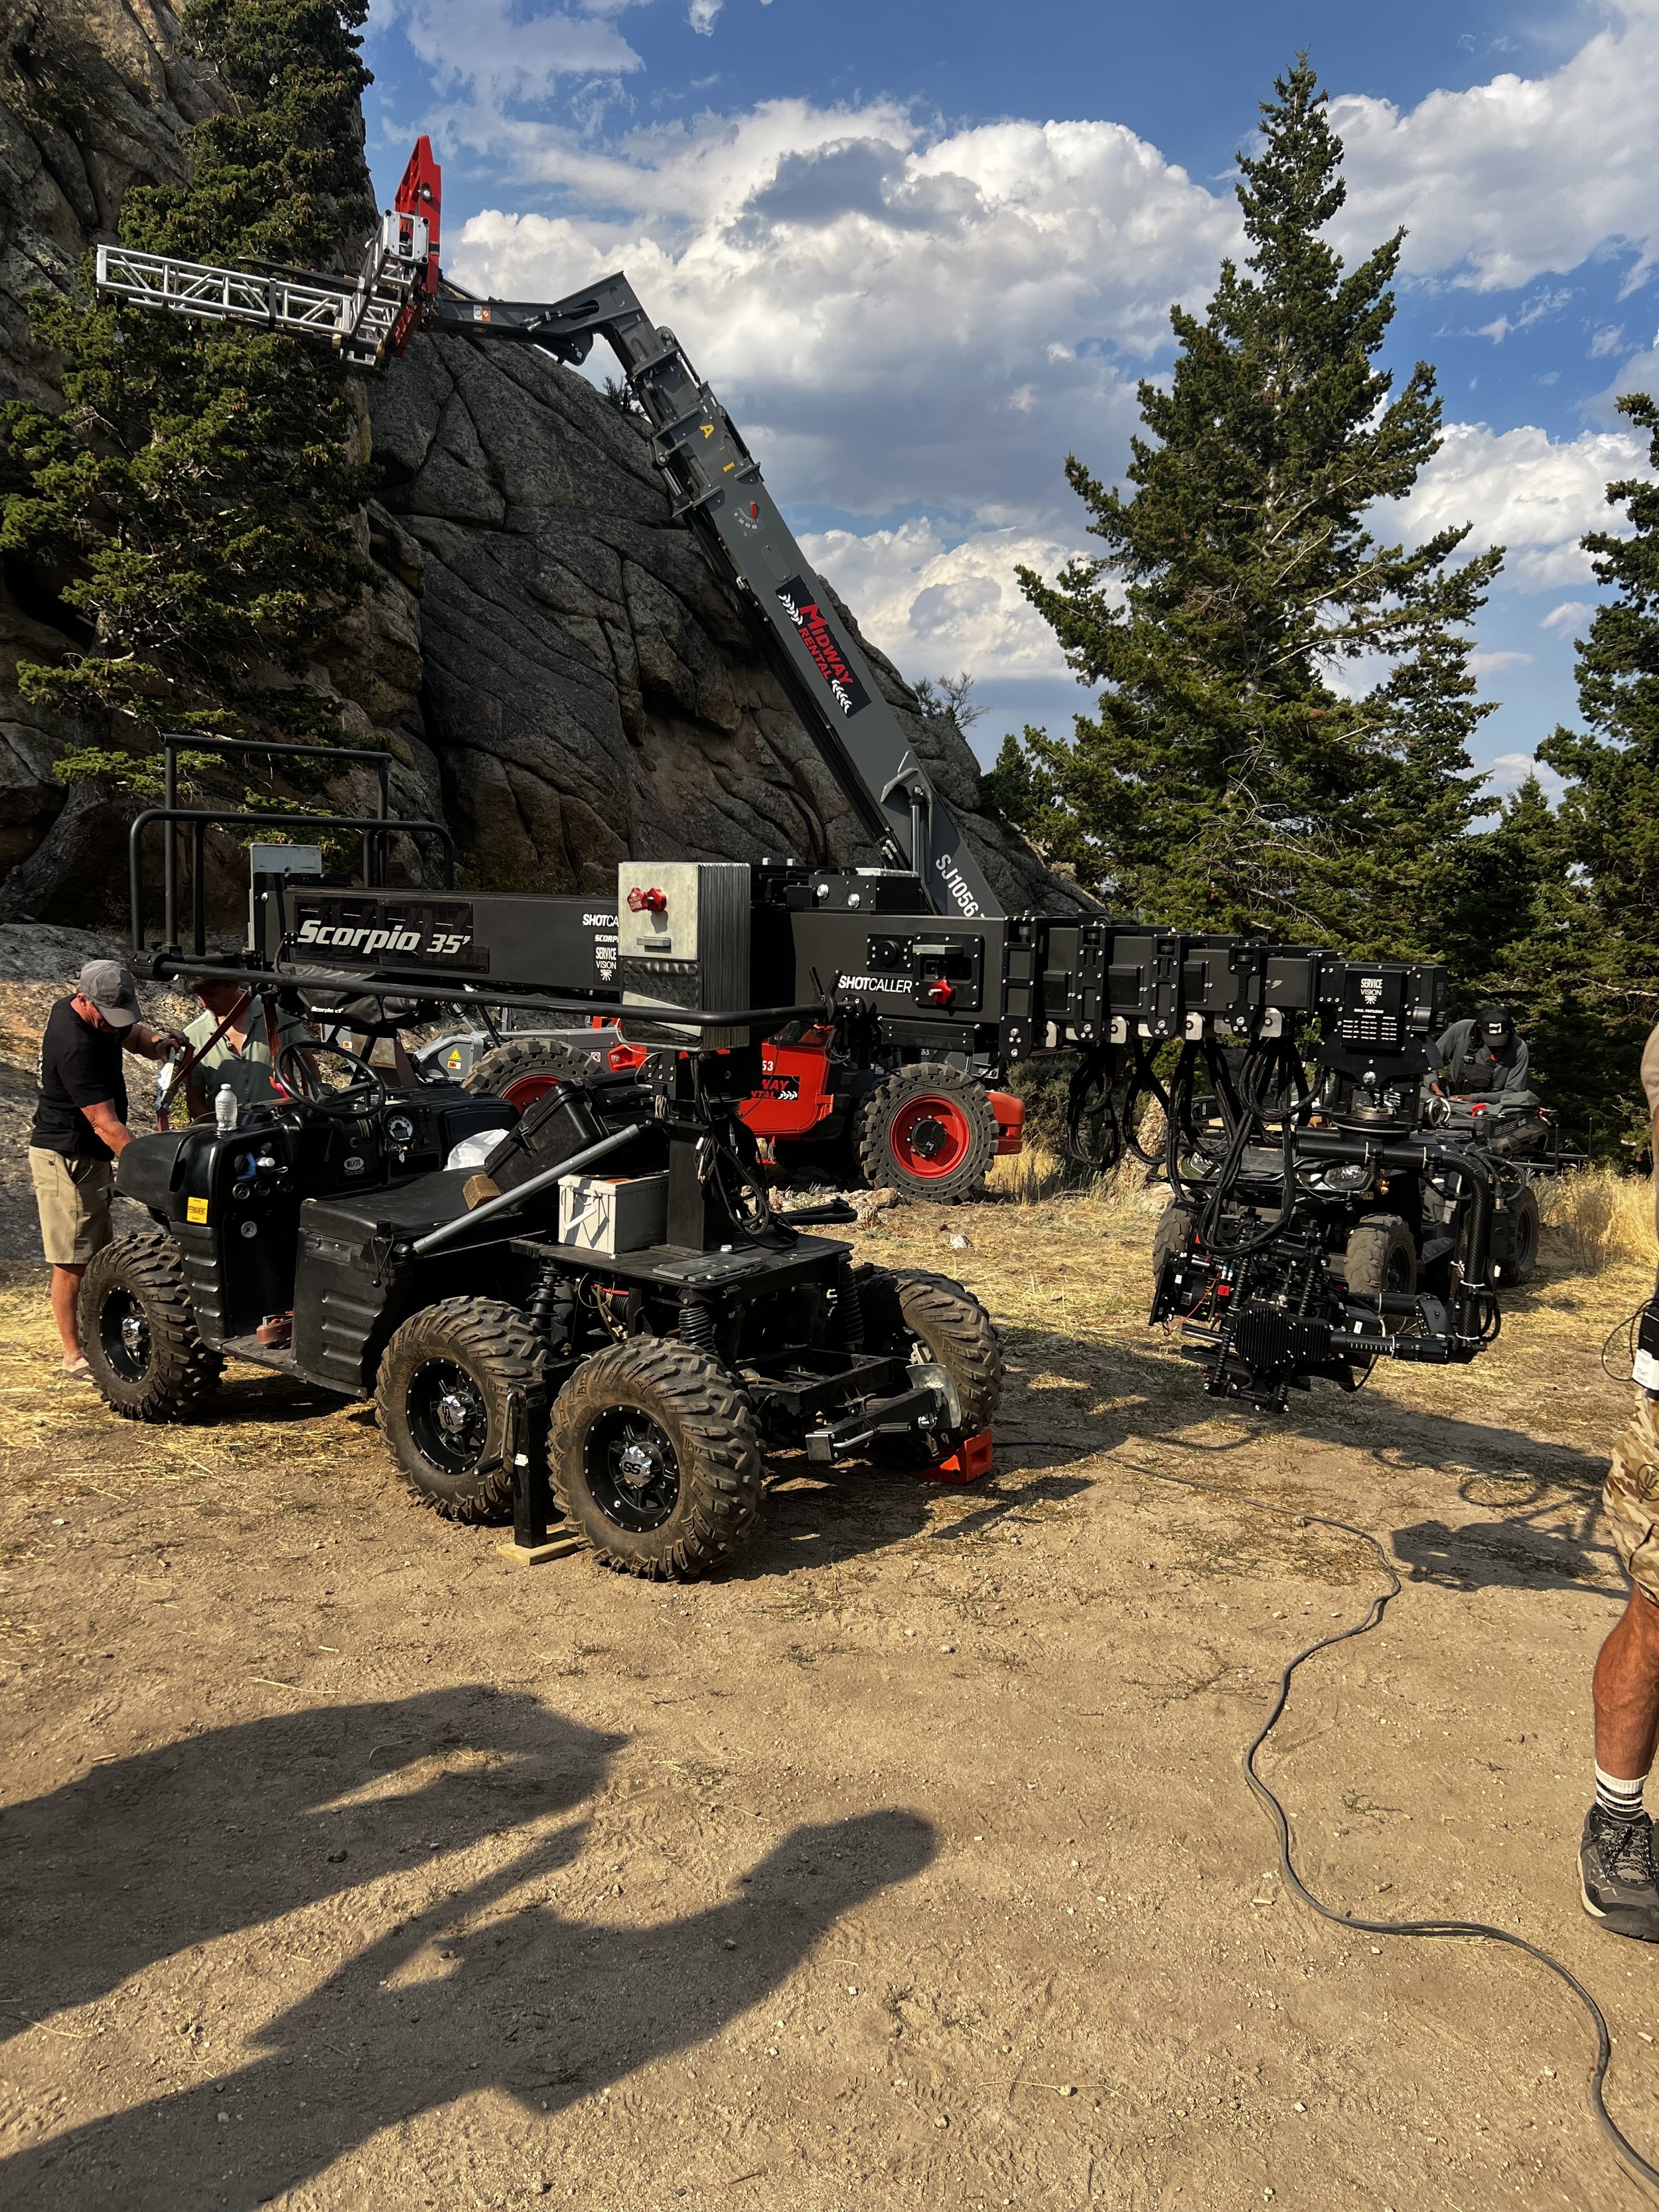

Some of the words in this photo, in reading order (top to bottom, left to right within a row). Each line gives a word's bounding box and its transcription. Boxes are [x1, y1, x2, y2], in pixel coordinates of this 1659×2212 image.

[798, 603, 854, 685] MIDWAY
[798, 627, 833, 680] RENTAL
[935, 853, 979, 918] SJ1056
[582, 913, 618, 927] SHOTCA
[297, 920, 421, 954] Scorpio
[426, 933, 471, 954] 35'
[595, 934, 618, 943] SCORP
[595, 946, 617, 961] SERVICE
[595, 960, 617, 970] VISION
[837, 975, 912, 994] SHOTCALLER
[1360, 978, 1384, 989] SERVICE
[762, 1078, 790, 1090] WAY
[751, 1090, 776, 1099] NTAL
[442, 1405, 454, 1426] SS
[622, 1461, 642, 1475] SS
